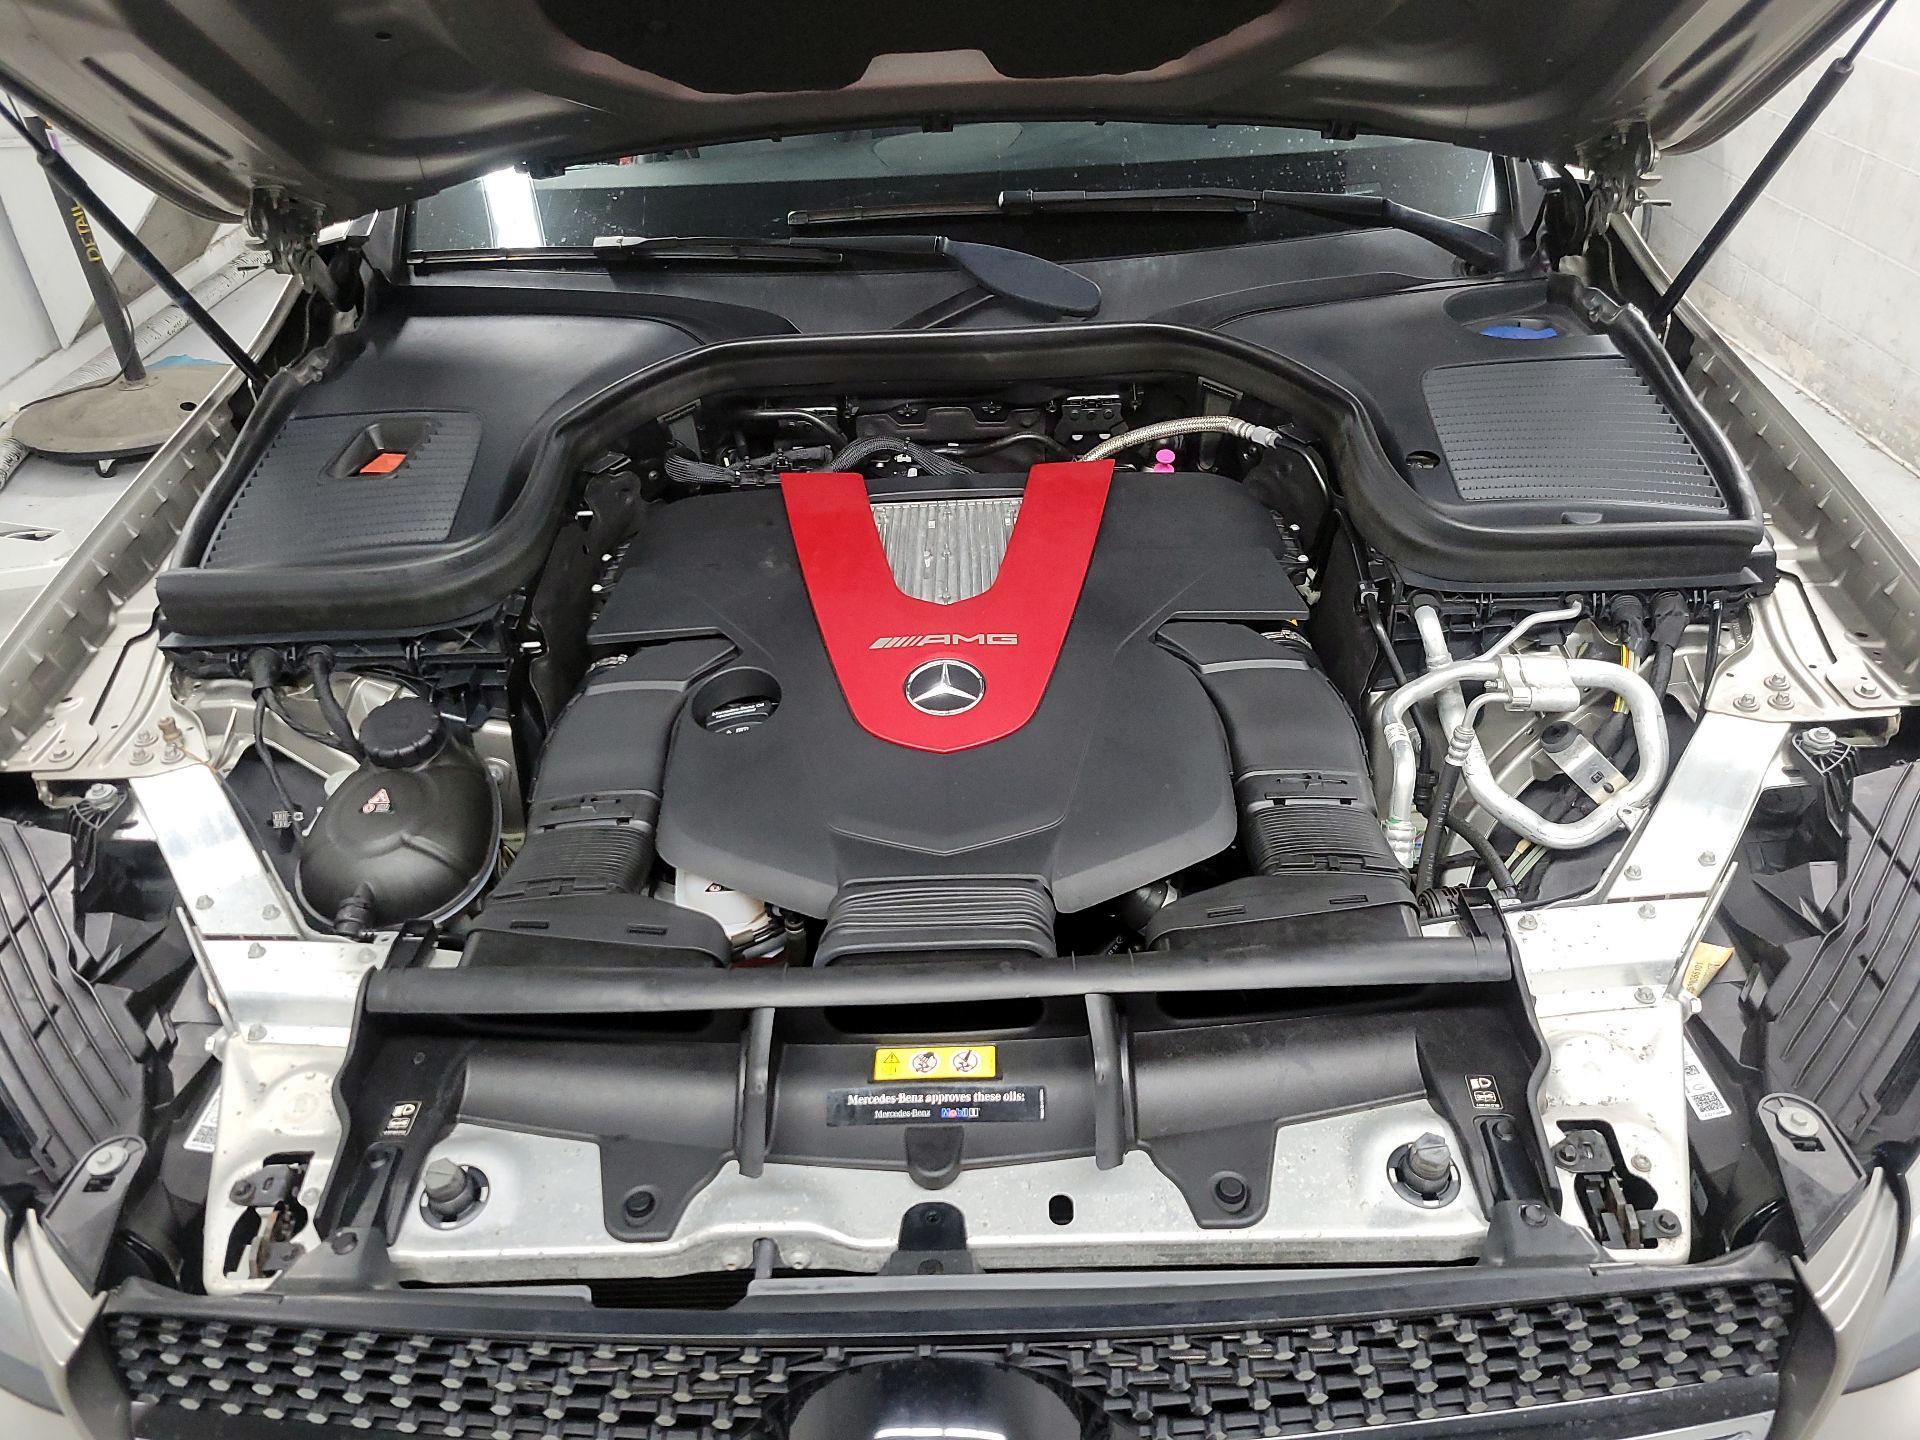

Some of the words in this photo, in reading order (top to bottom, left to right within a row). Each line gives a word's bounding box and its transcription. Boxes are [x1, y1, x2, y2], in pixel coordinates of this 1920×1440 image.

[915, 633, 1018, 647] AMG
[847, 1092, 924, 1106] Mercedes-Benz
[925, 1092, 971, 1105] approves
[973, 1091, 1001, 1102] these
[1002, 1091, 1025, 1102] oils:
[874, 1108, 931, 1119] Mercedes-Benz
[940, 1107, 969, 1118] Mobil
